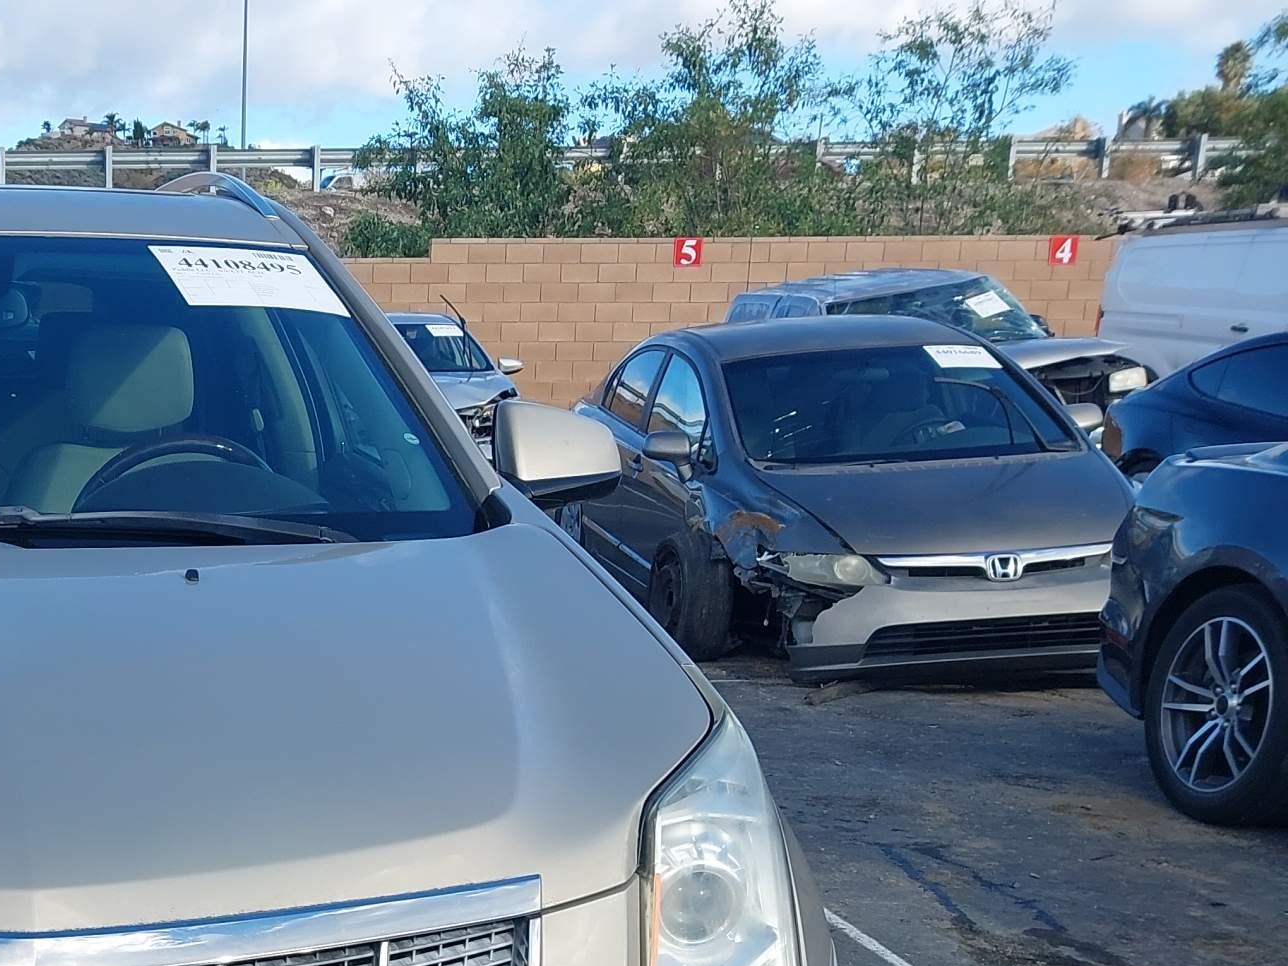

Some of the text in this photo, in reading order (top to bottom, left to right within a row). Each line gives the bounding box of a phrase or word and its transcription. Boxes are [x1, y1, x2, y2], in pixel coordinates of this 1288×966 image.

[680, 239, 697, 265] 5
[1055, 238, 1073, 264] 4
[177, 256, 303, 276] 44108495
